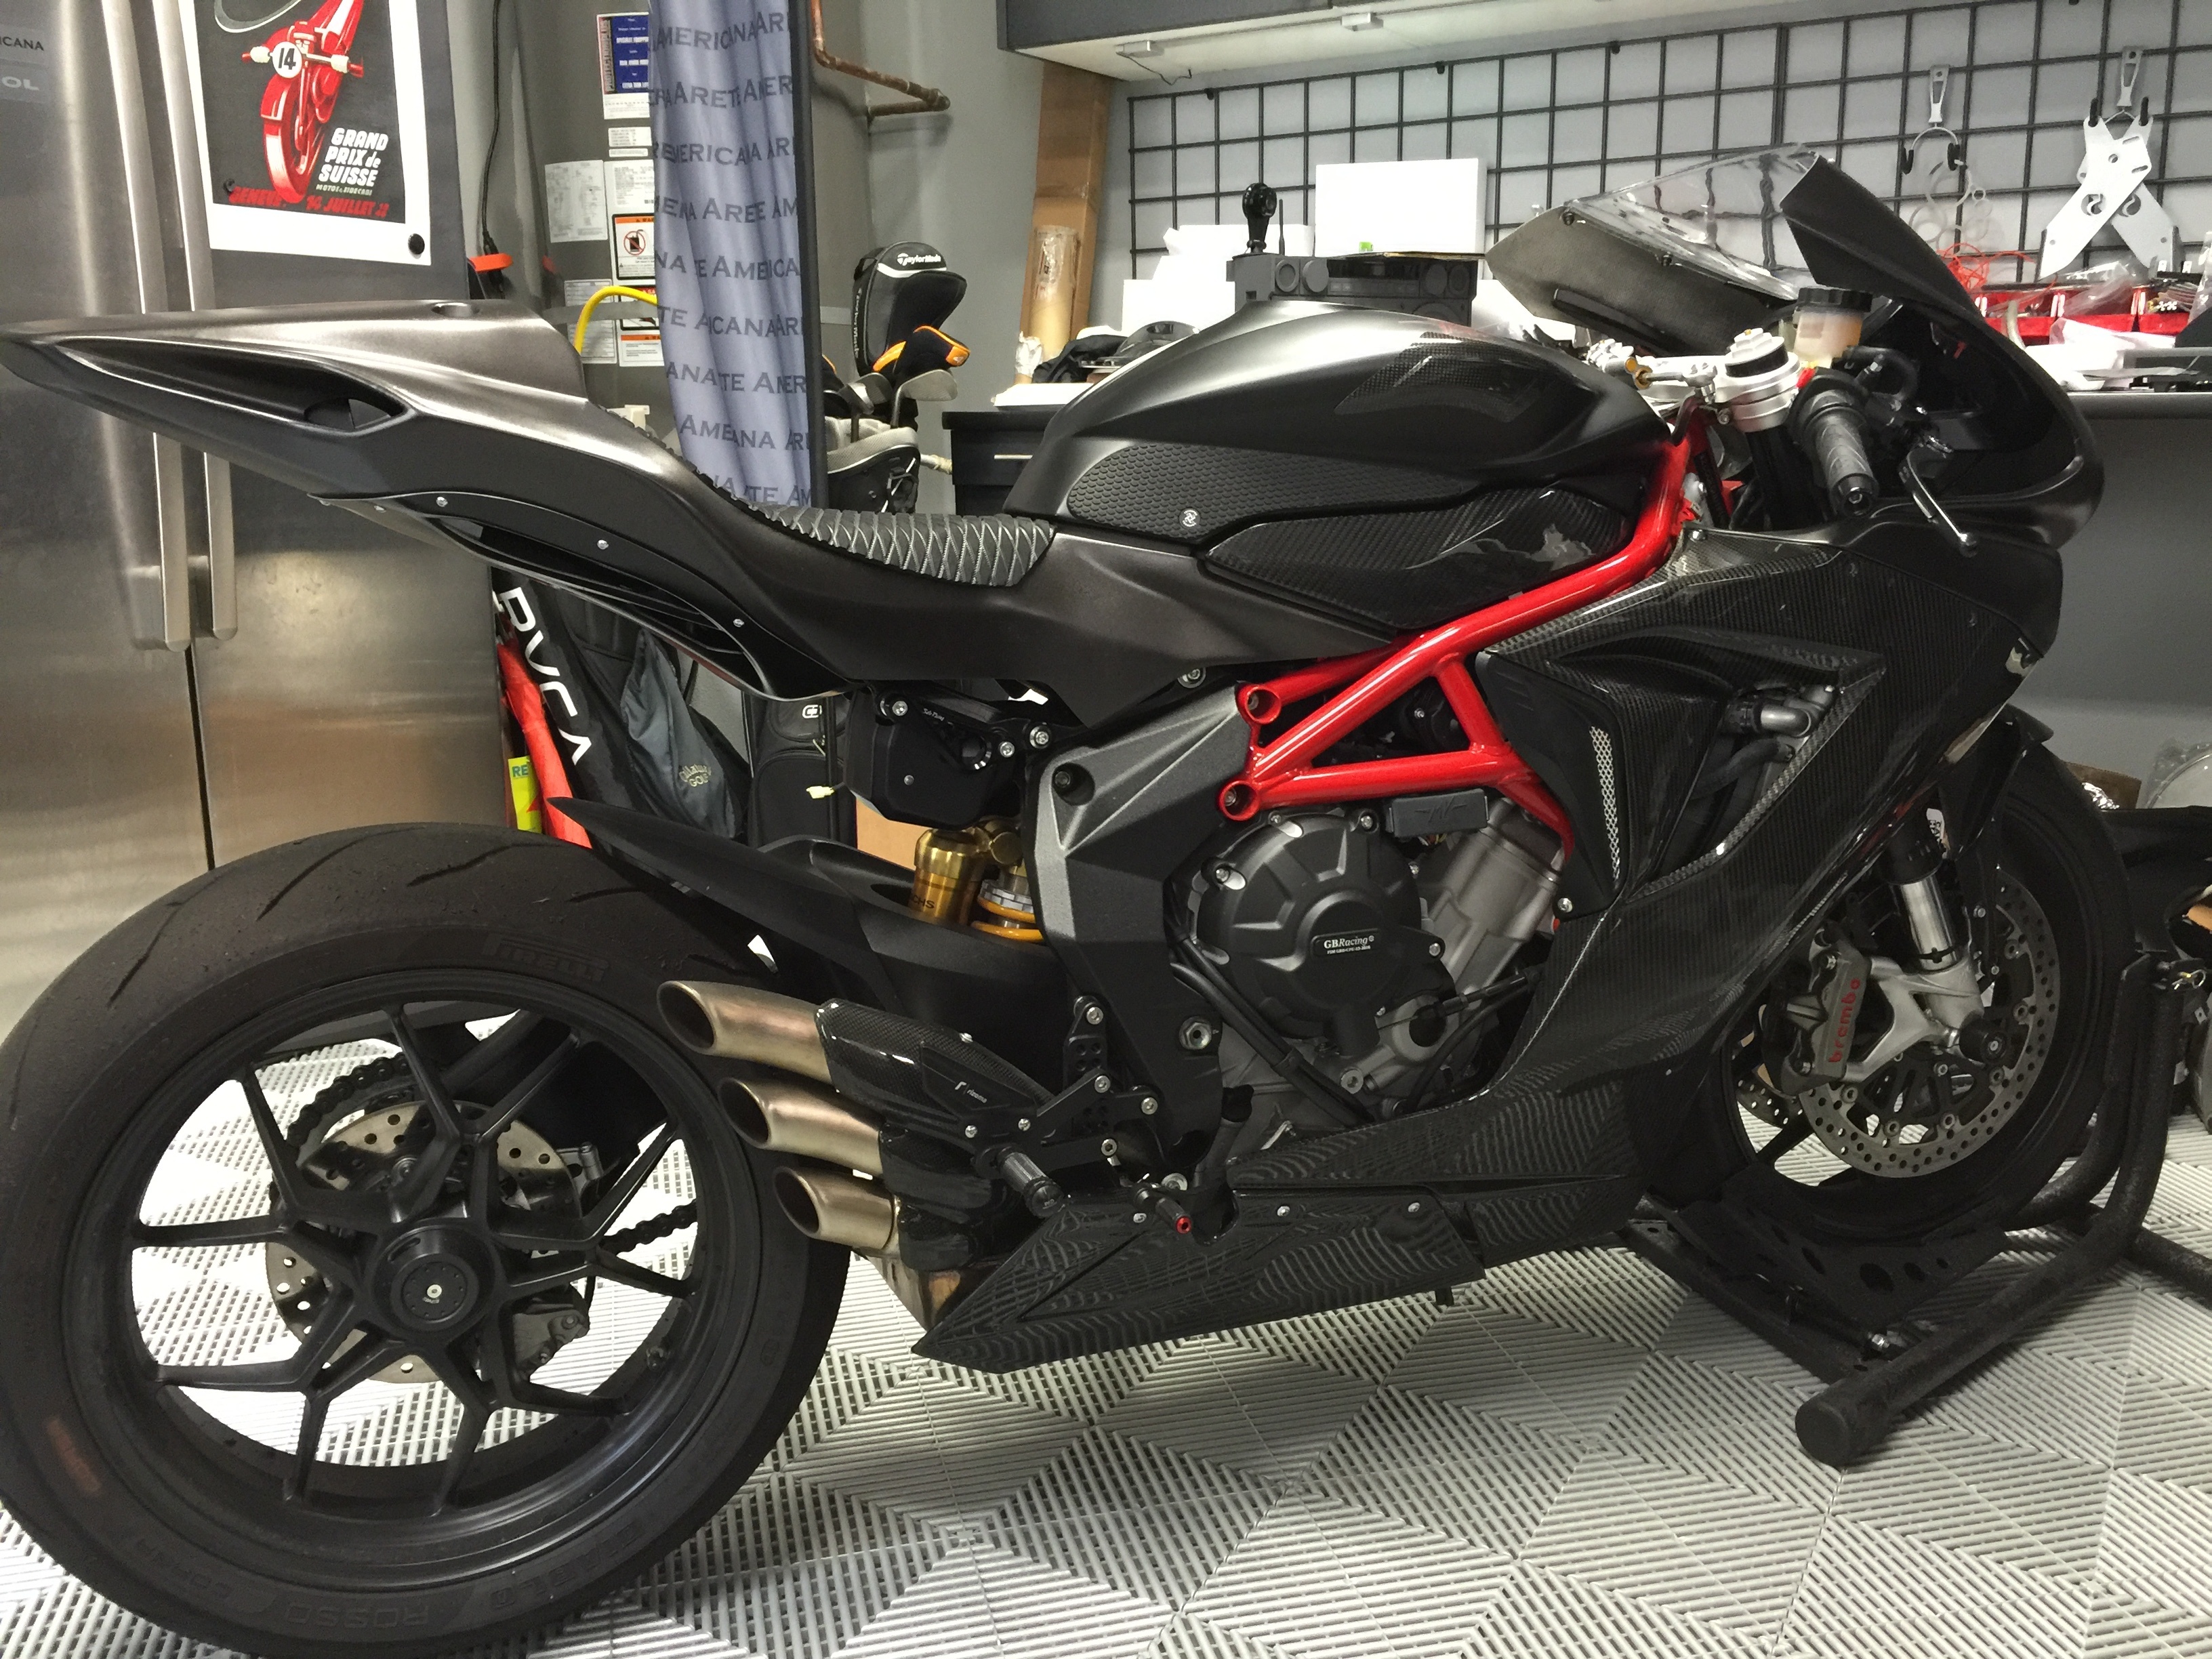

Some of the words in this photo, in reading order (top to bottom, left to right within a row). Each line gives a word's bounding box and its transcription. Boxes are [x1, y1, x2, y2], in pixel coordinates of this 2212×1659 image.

[278, 48, 296, 70] 14
[331, 127, 389, 151] GRAND
[325, 146, 364, 166] PRIX
[365, 151, 382, 169] de
[318, 164, 378, 187] SUISSE
[480, 933, 610, 983] PIRELLI
[1828, 977, 1861, 1063] brembo
[284, 1602, 429, 1630] ROSSO
